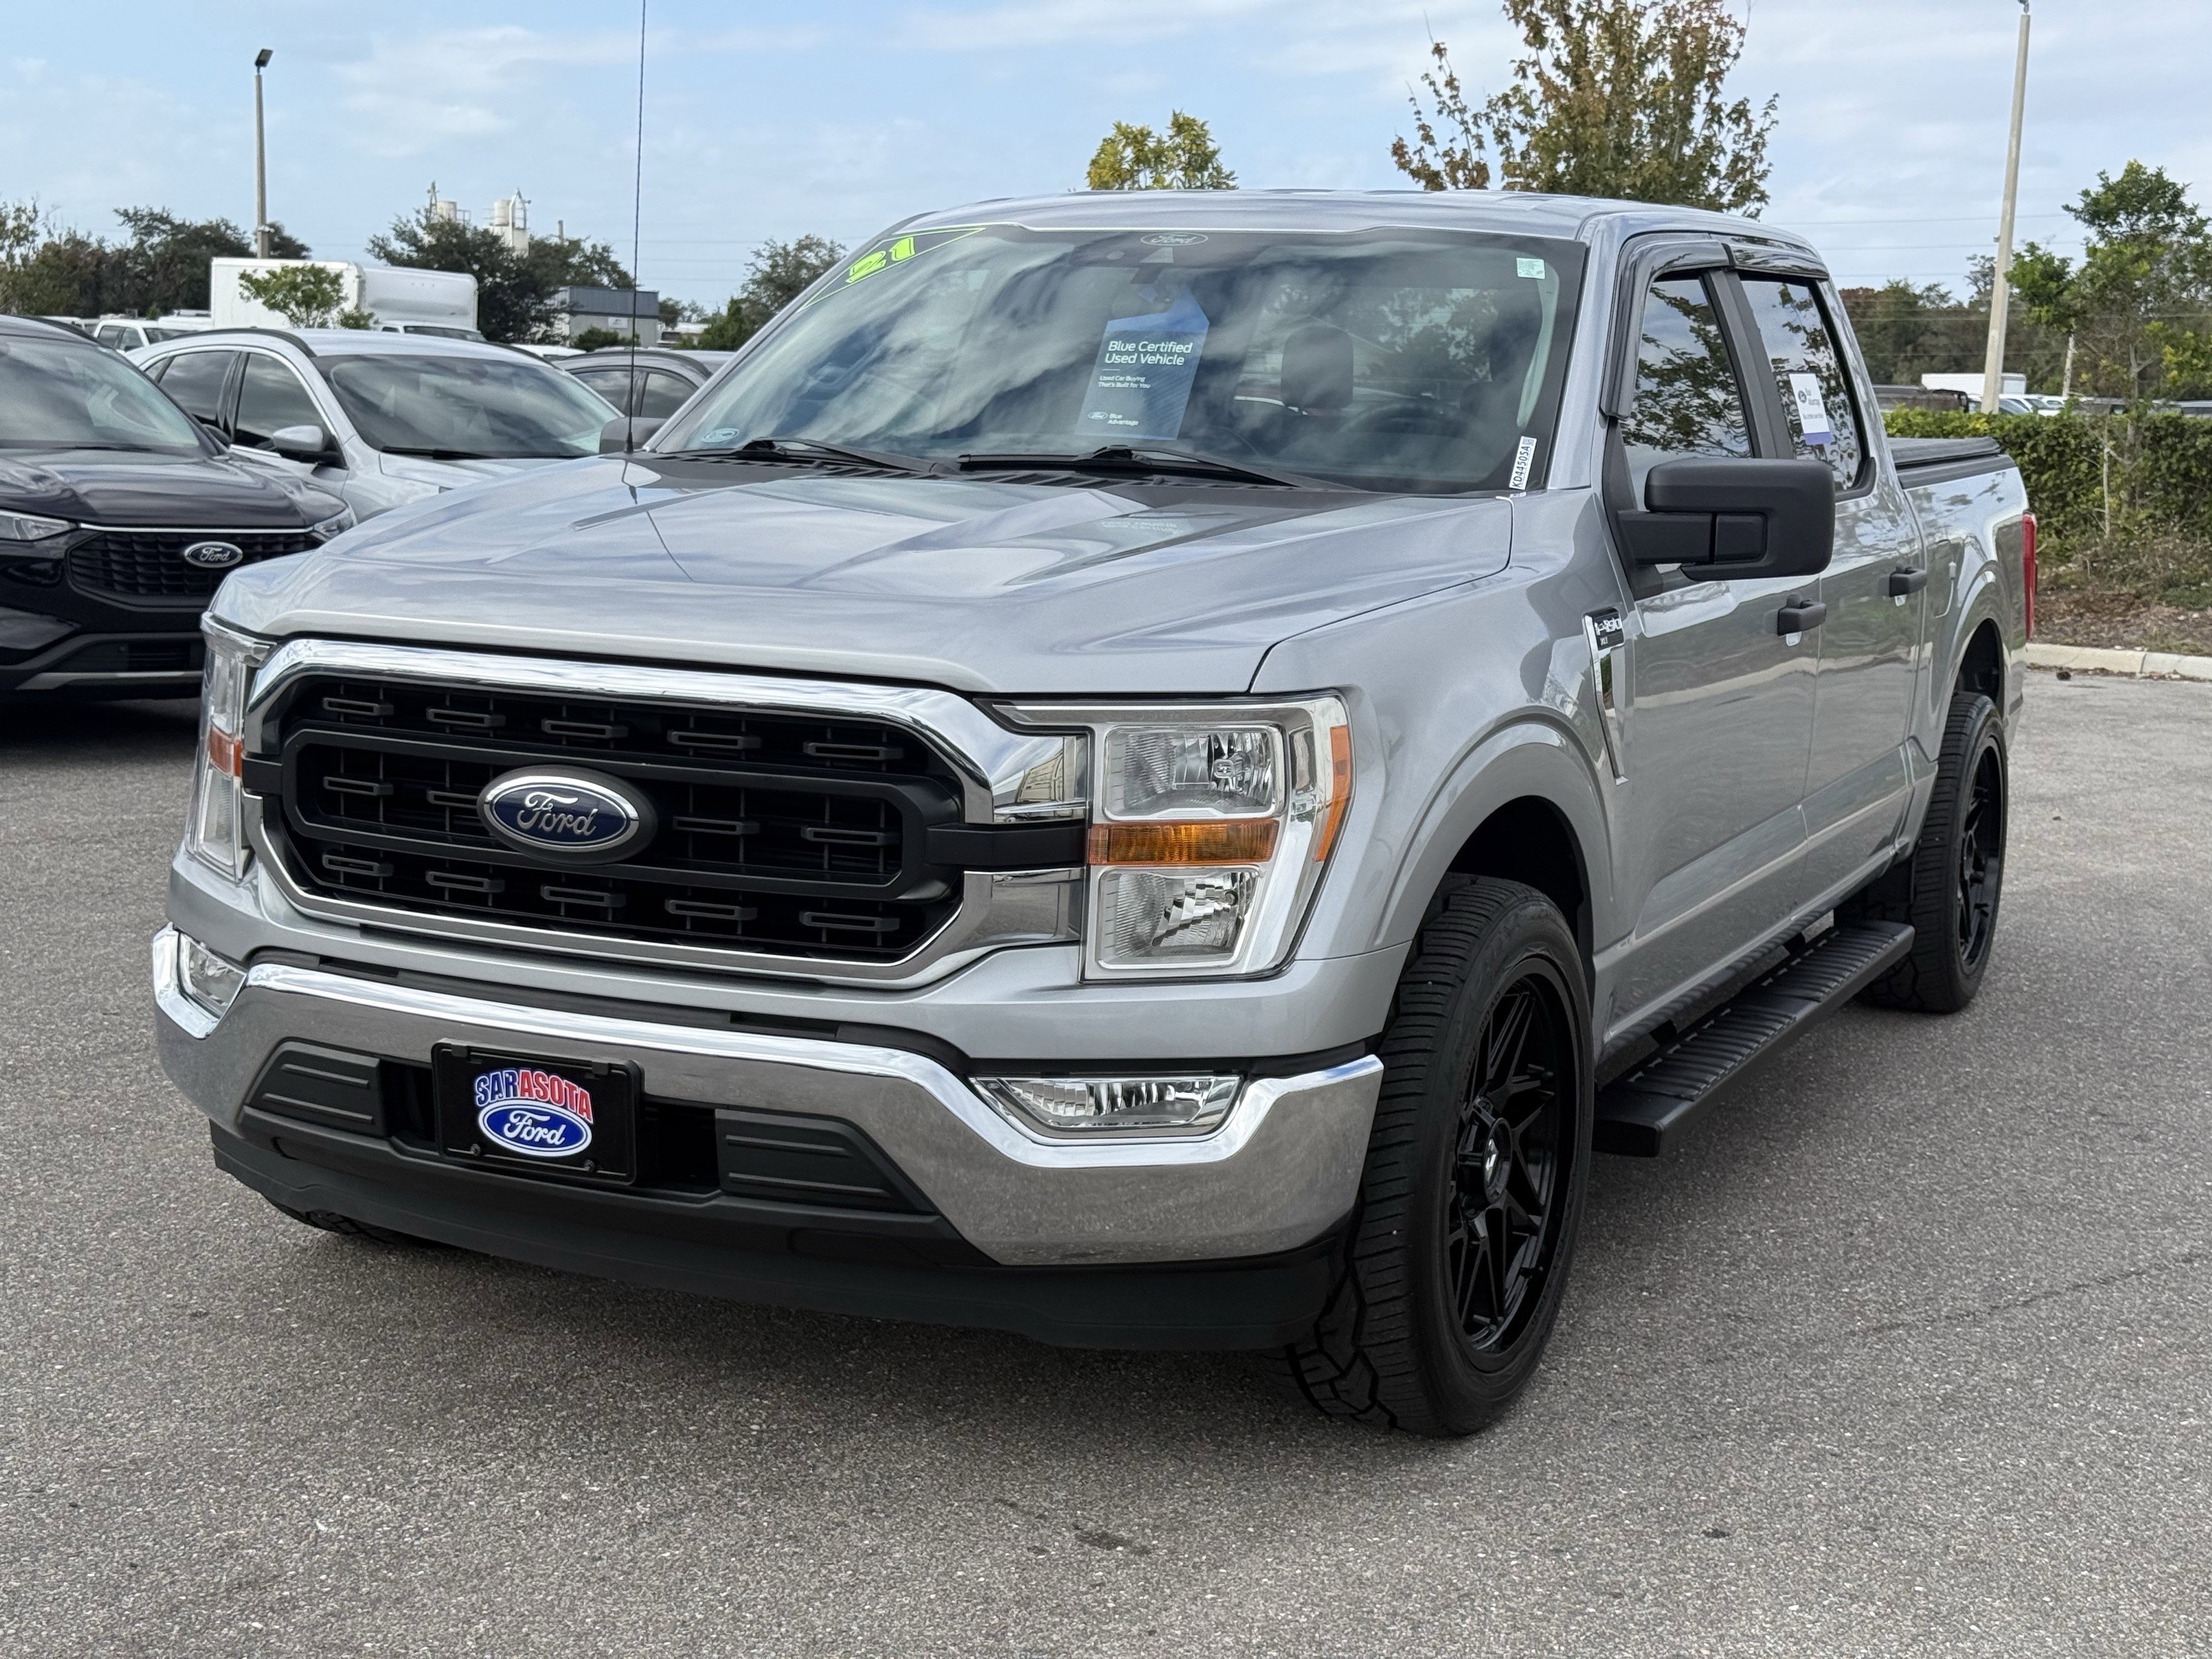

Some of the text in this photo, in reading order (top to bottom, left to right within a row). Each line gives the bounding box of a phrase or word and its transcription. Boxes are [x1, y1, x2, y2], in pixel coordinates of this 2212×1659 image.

[1151, 234, 1197, 244] Ford
[845, 236, 915, 283] 21
[1105, 353, 1184, 365] Used Vehicle
[1108, 341, 1193, 353] Blue Certified
[200, 547, 231, 561] Ford
[517, 792, 599, 836] Ford
[475, 1068, 594, 1125] SARASOTA
[504, 1110, 565, 1146] Ford
